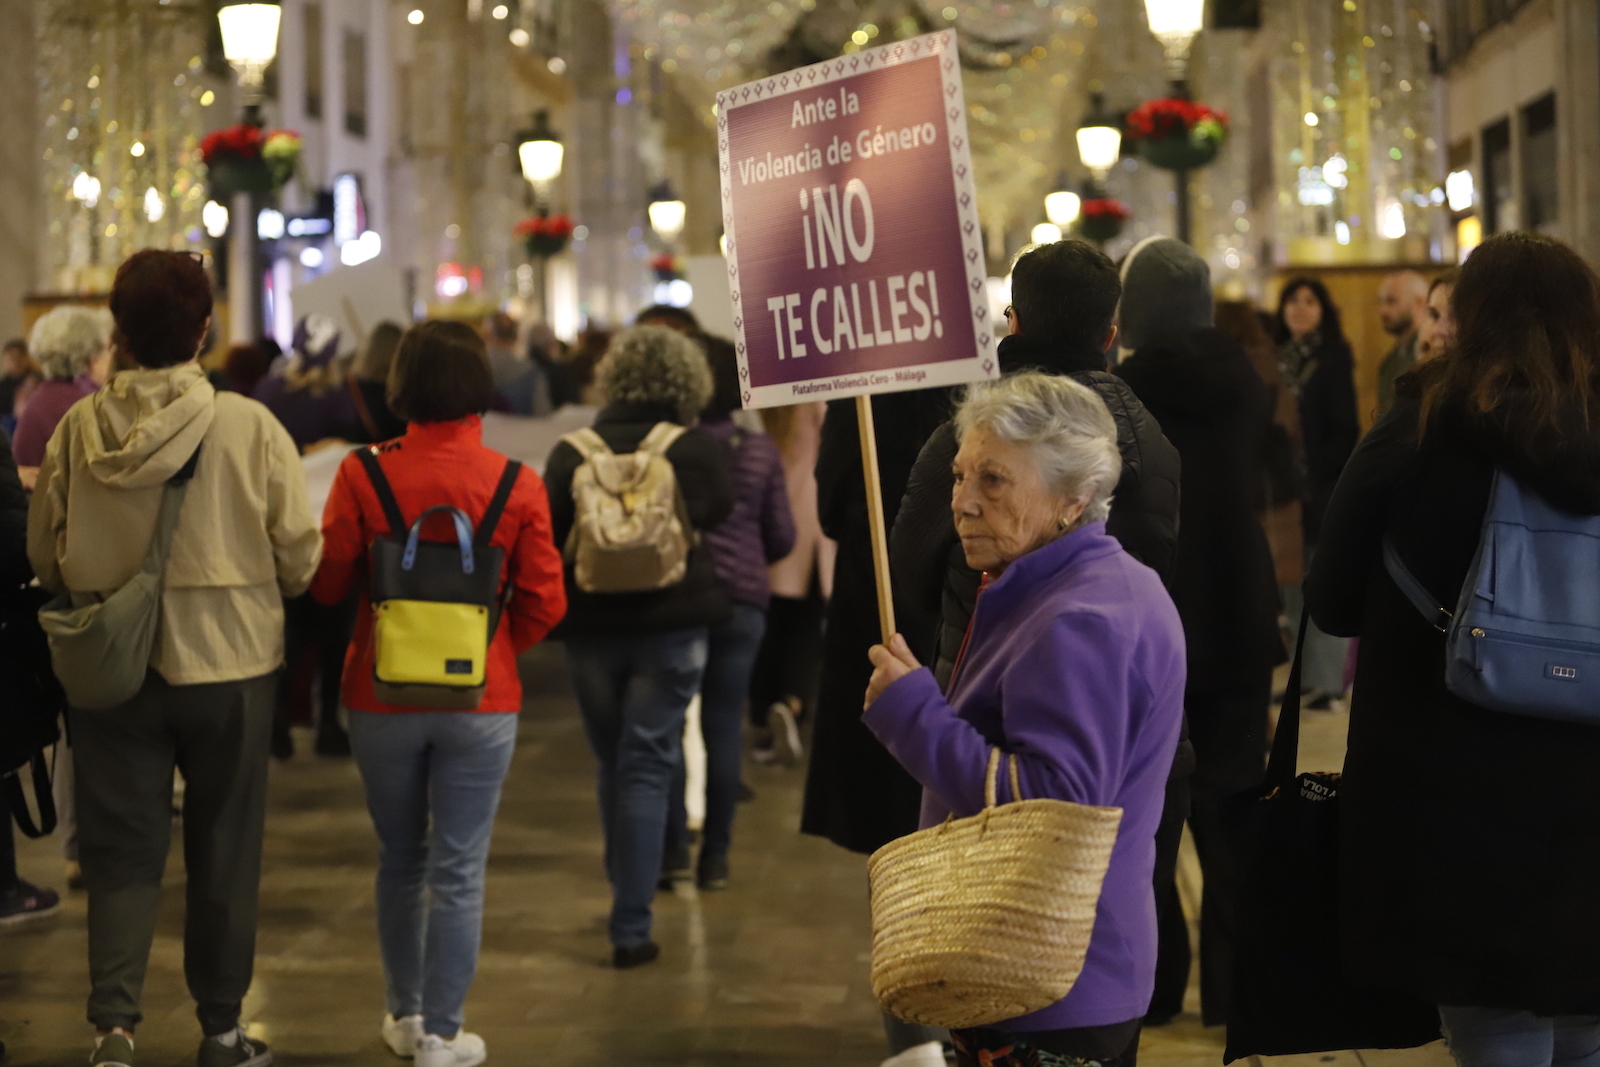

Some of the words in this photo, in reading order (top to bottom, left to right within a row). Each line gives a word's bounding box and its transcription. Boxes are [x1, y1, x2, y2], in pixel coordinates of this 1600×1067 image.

[791, 100, 836, 129] Ante
[840, 86, 860, 116] la
[738, 144, 822, 185] Violencia
[826, 135, 852, 166] de
[856, 122, 936, 159] Género
[799, 177, 874, 270] ¡NO
[767, 293, 807, 360] TE
[810, 270, 943, 355] CALLES!
[792, 382, 832, 396] Plataforma
[832, 376, 868, 390] Violencia
[869, 374, 889, 386] Cero
[895, 369, 926, 383] Málaga
[1303, 778, 1329, 796] LOLA
